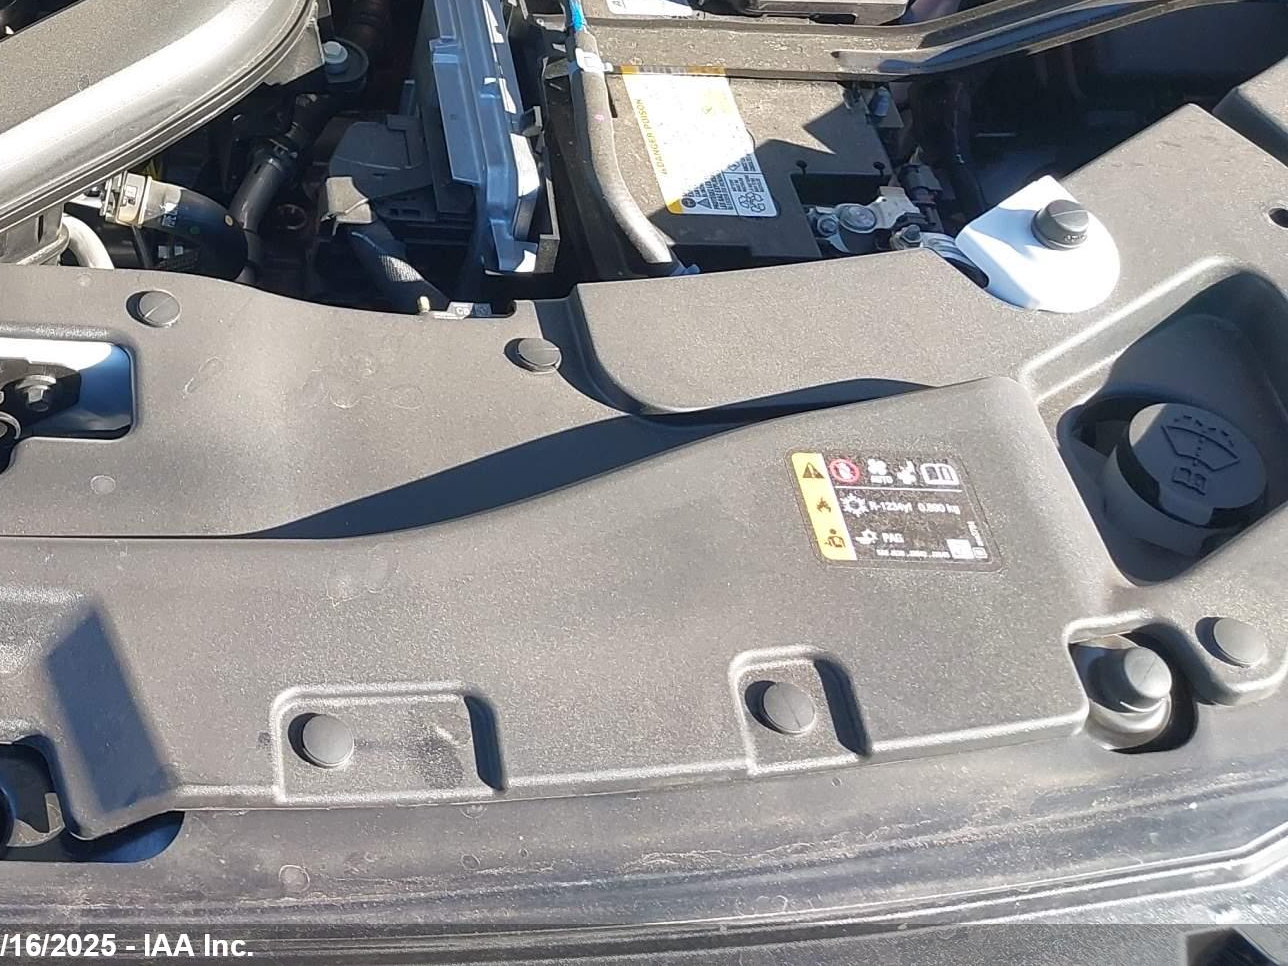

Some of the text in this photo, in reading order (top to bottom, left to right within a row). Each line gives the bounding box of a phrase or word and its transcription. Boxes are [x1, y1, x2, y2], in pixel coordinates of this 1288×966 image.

[635, 99, 665, 168] DANGER POISON
[881, 532, 905, 544] PAG
